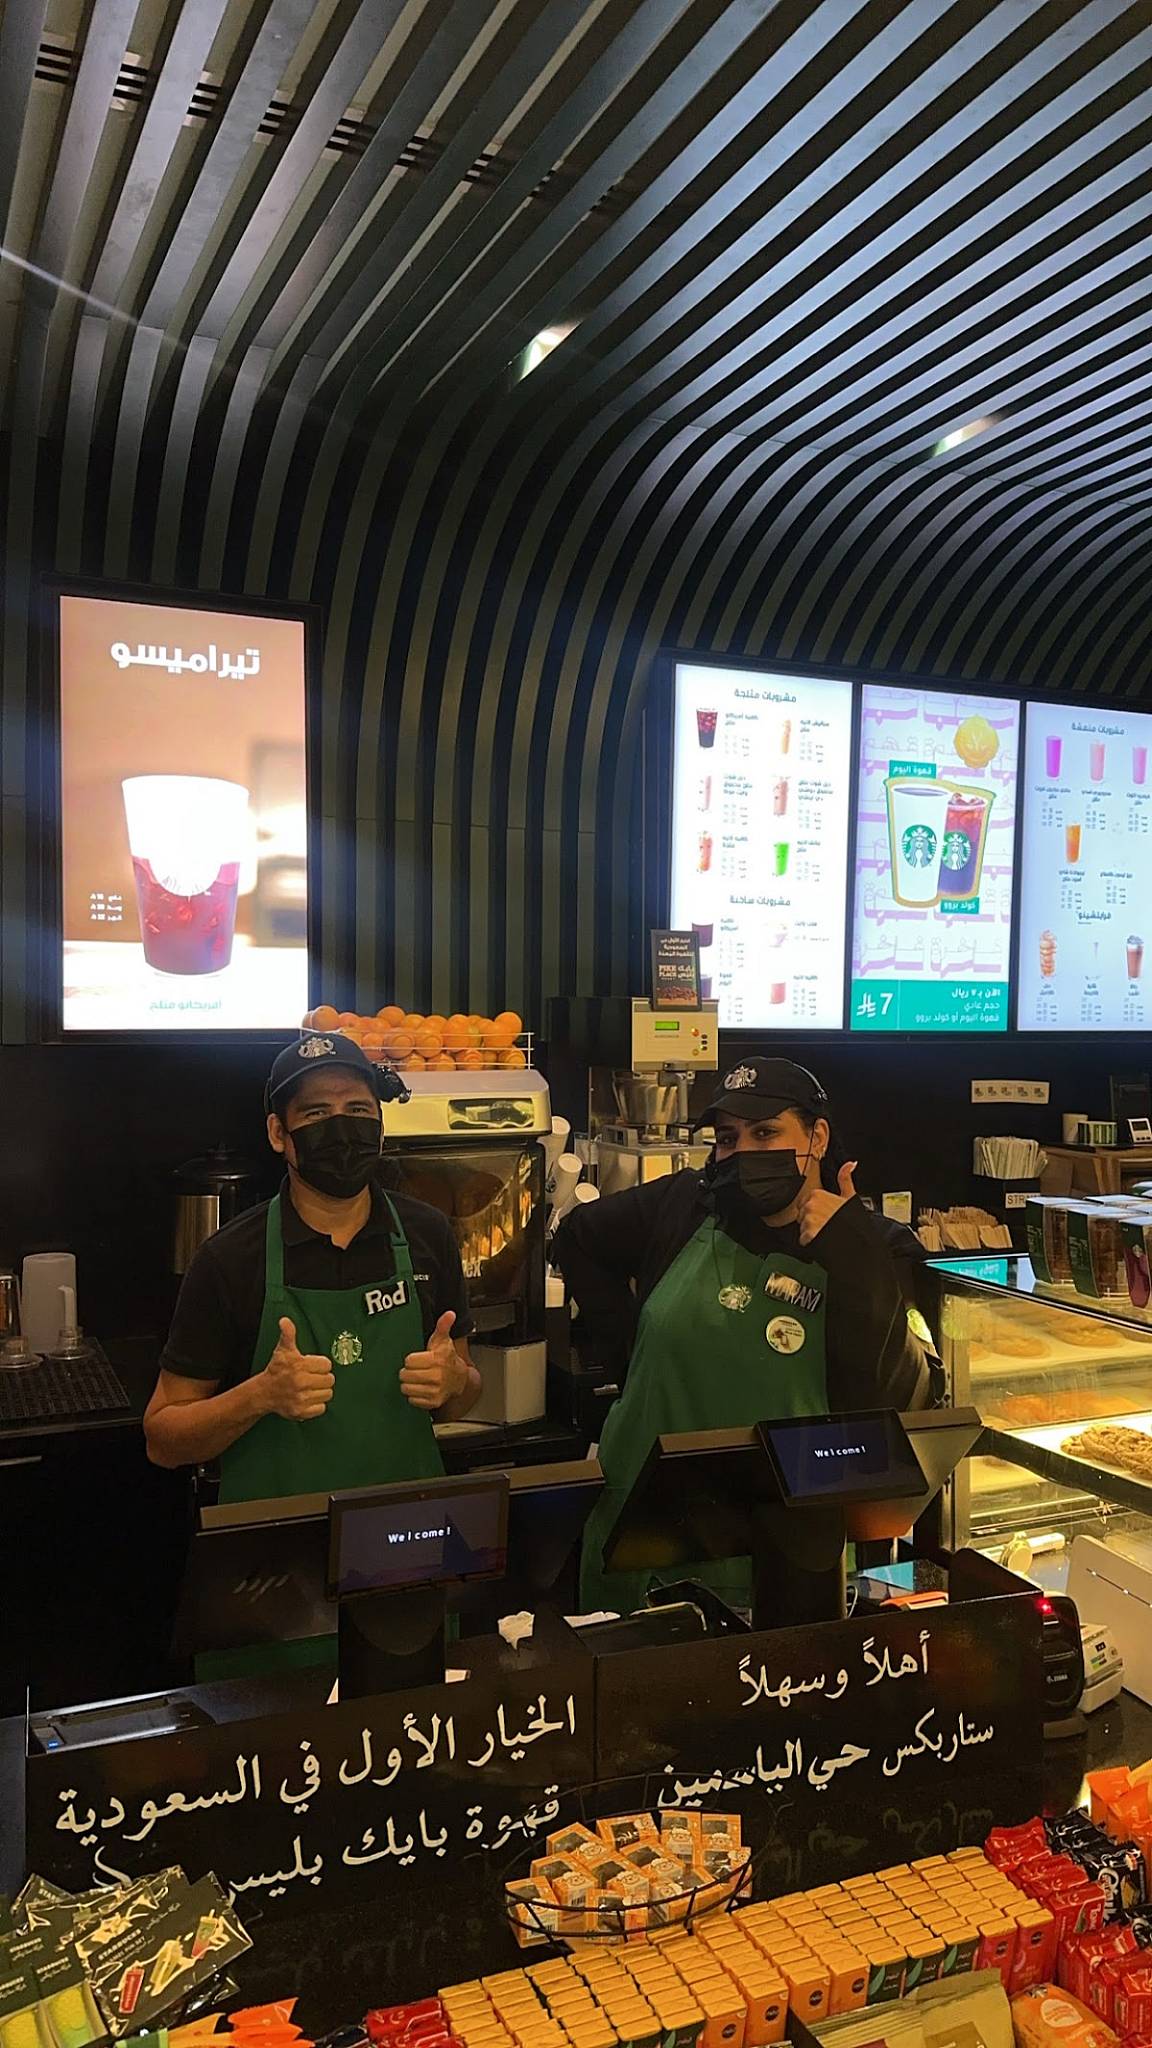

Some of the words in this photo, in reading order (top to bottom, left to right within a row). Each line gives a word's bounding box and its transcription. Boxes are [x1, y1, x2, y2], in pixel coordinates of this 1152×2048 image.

[110, 641, 260, 681] تيراميسو
[734, 688, 760, 699] مثلجة
[762, 691, 797, 702] مشروبات
[757, 896, 791, 906] مشروبات
[880, 992, 894, 1015] 7
[952, 987, 969, 999] ريال
[364, 1280, 407, 1316] Rod
[814, 1445, 866, 1459] Welcome!
[388, 1526, 451, 1544] Welcome!
[338, 1711, 455, 1786] الأول
[467, 1694, 575, 1767] الخيار
[882, 1707, 995, 1777] ستاربكس
[279, 1740, 321, 1814] في
[657, 1737, 803, 1808] الياسمين
[807, 1743, 871, 1792] حي
[55, 1754, 261, 1848] السعودية
[465, 1784, 560, 1850] قهوة
[342, 1809, 448, 1867] بايك
